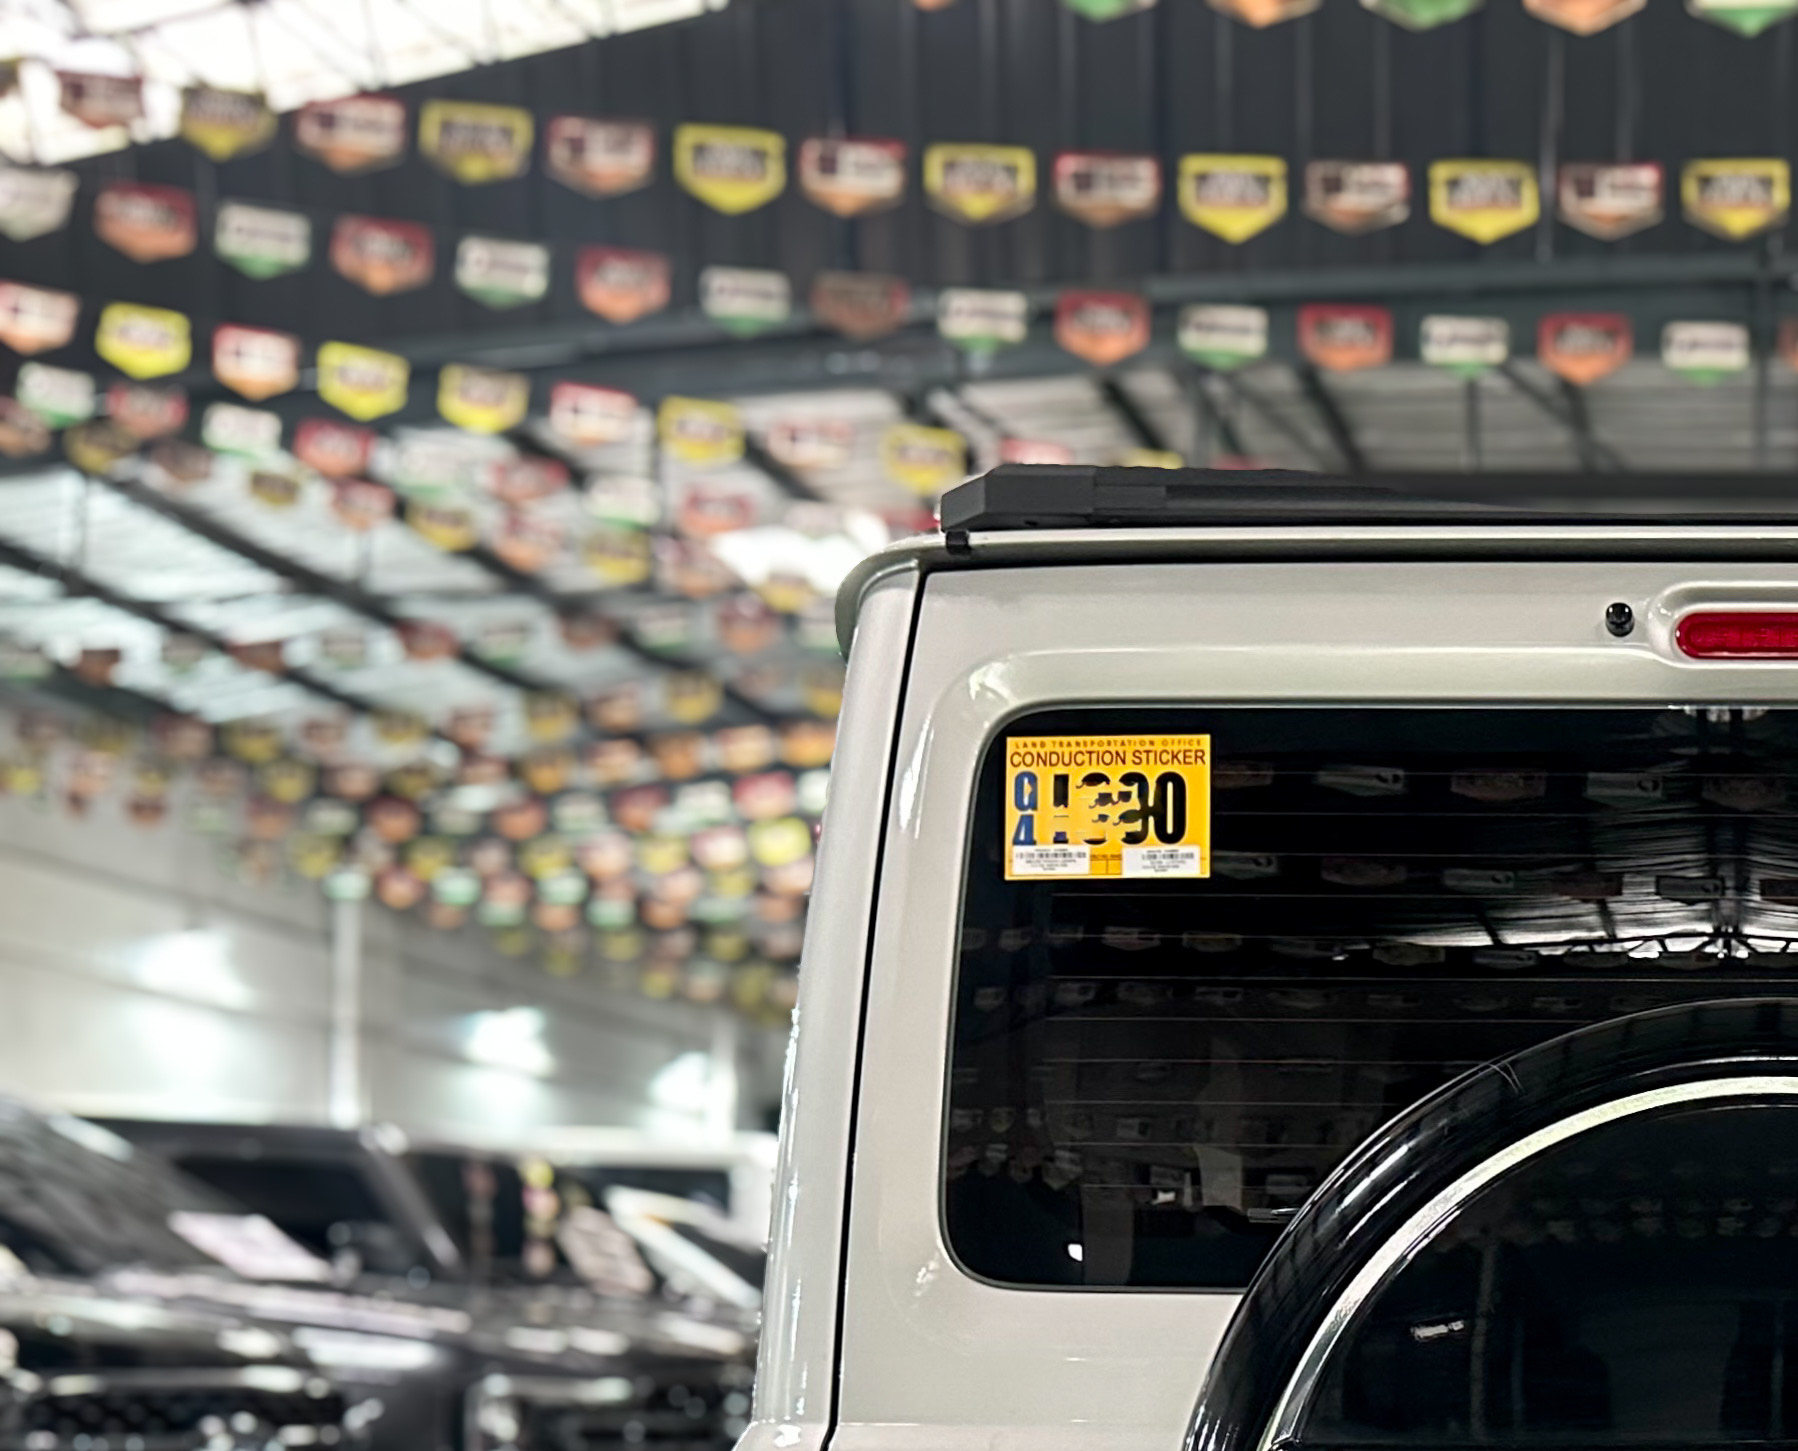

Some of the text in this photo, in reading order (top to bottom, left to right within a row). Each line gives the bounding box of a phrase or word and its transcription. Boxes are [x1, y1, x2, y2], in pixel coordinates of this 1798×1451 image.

[1015, 738, 1202, 749] LAND TRANSPORTATION OFFICE
[1009, 749, 1206, 768] CONDUCTION STICKER
